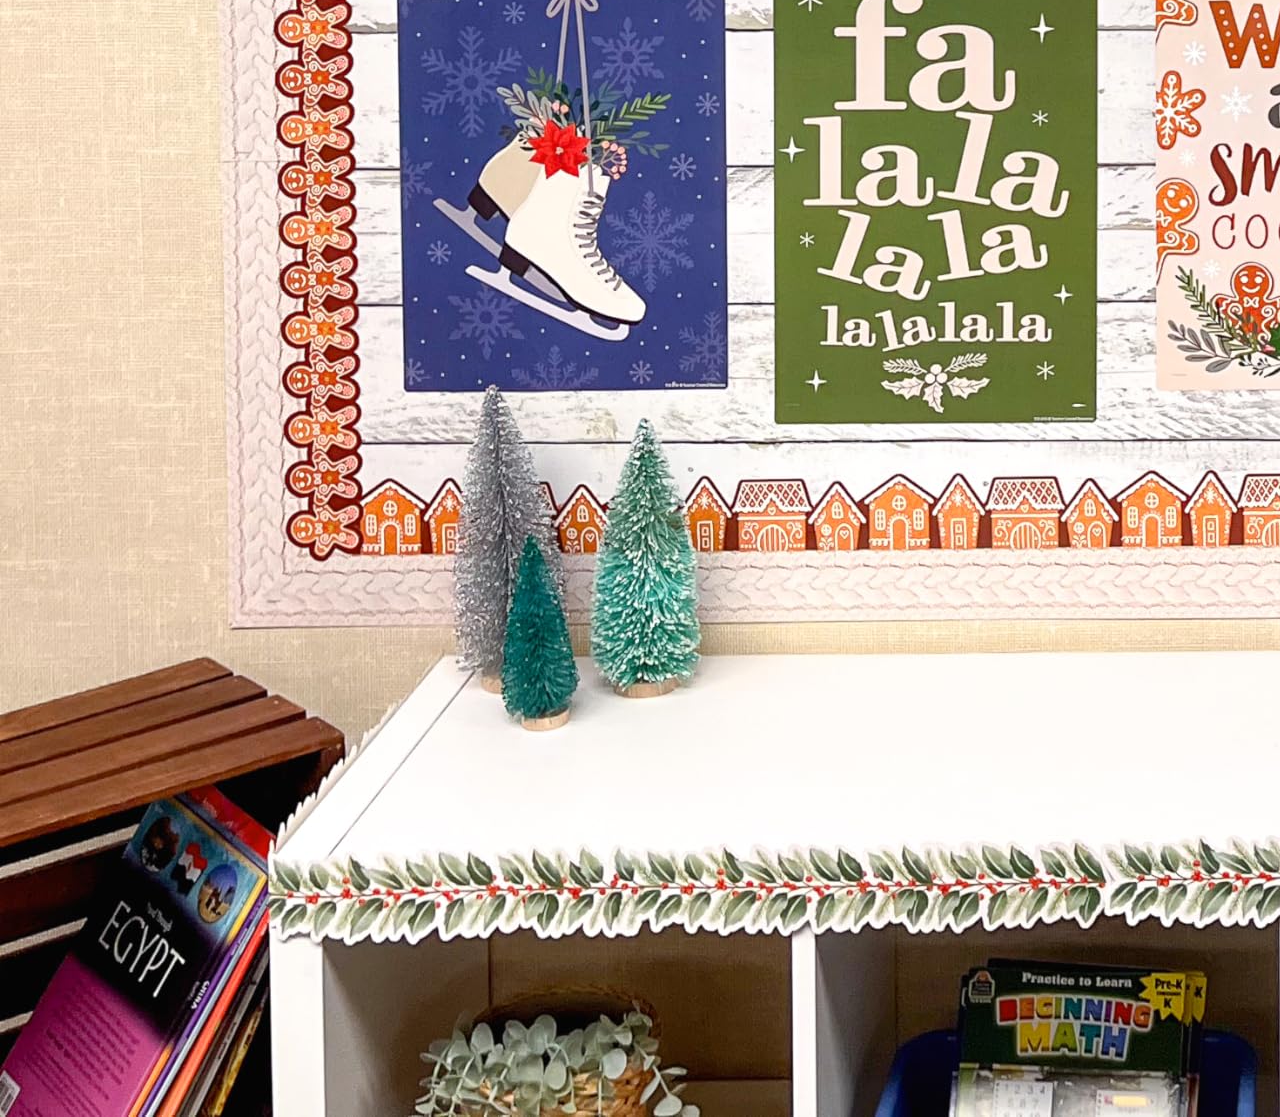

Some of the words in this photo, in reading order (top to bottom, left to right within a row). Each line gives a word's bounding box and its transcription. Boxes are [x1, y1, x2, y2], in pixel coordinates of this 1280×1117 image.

[98, 900, 186, 998] EGYPT
[1022, 971, 1074, 987] Practice
[1079, 974, 1092, 987] to
[1096, 975, 1133, 988] Learn
[1155, 978, 1184, 990] Pre-K
[997, 995, 1153, 1031] BEGINNING
[1163, 998, 1172, 1009] K
[1018, 1022, 1129, 1059] MATH
